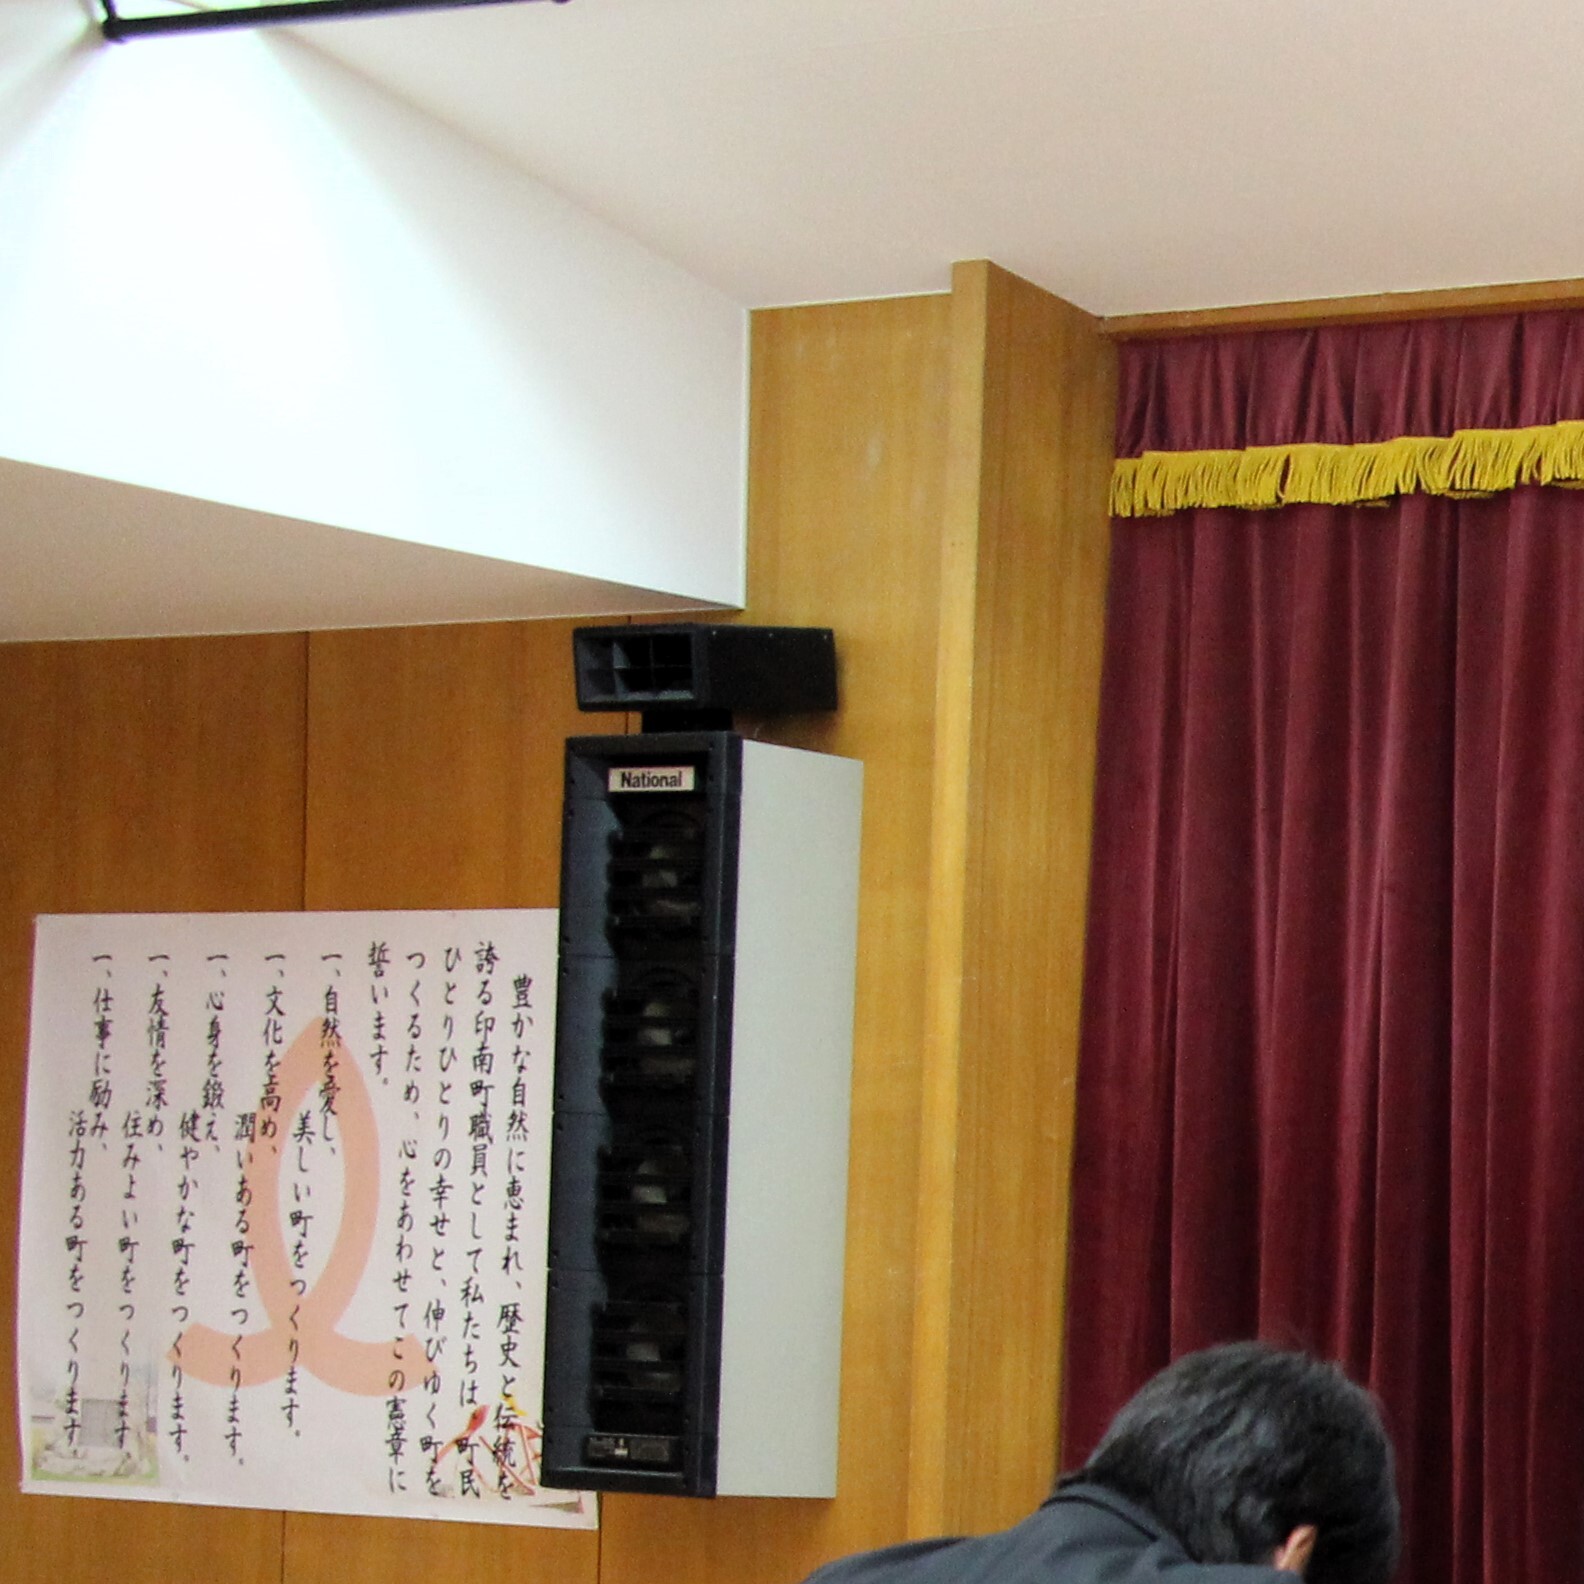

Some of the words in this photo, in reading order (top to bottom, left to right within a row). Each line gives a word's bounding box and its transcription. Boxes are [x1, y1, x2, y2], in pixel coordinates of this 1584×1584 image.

[620, 770, 683, 789] National
[146, 953, 170, 1152] 一、友情を深め、
[368, 941, 391, 1085] 誓います。
[114, 1110, 143, 1459] 住みよい町をつくります。
[169, 1108, 202, 1463] 健やかな町をつくります。
[224, 1112, 257, 1466] 潤いある町をつくります。
[281, 1111, 316, 1438] 美しい町をつくります。
